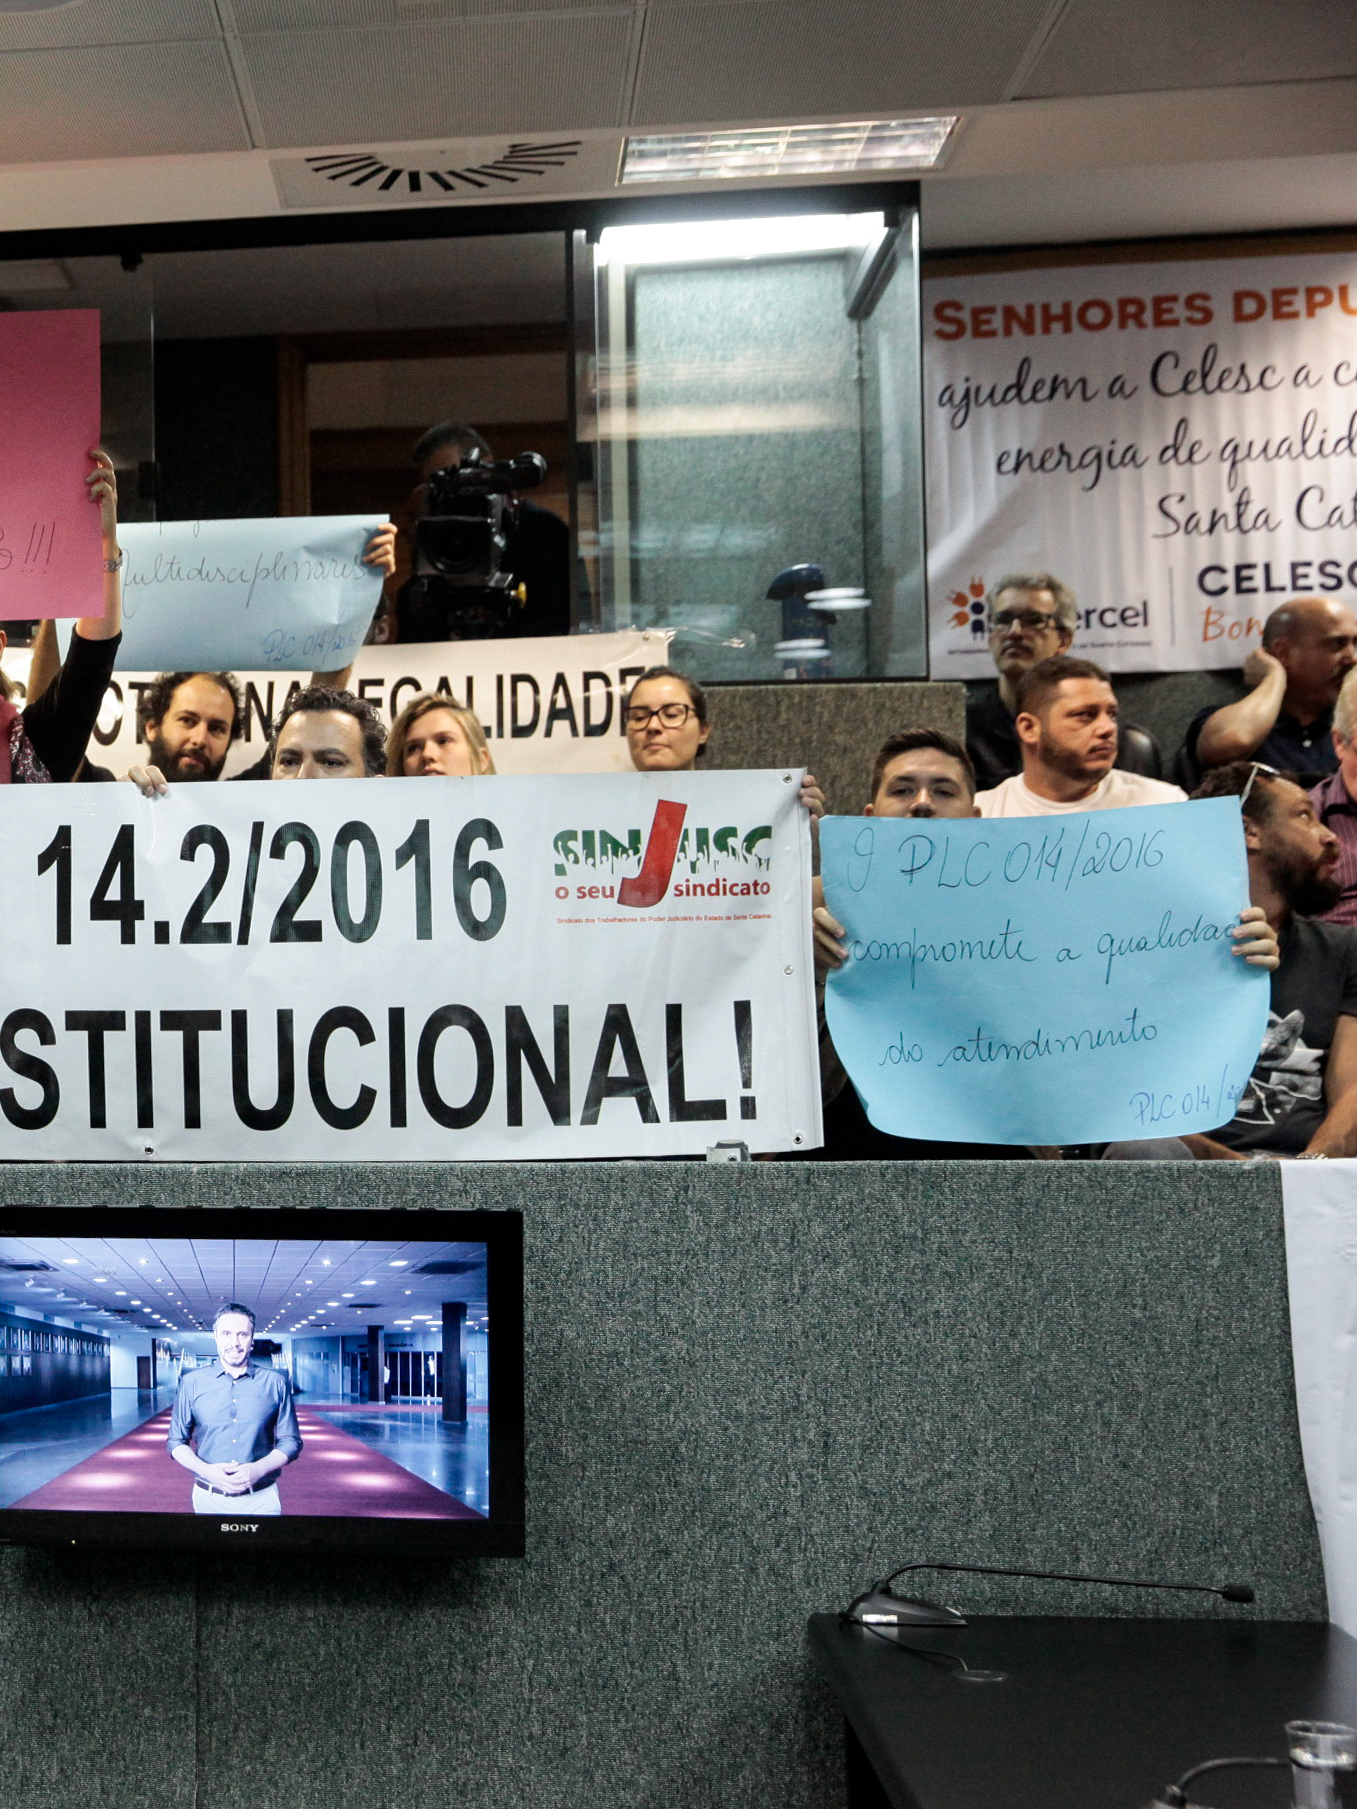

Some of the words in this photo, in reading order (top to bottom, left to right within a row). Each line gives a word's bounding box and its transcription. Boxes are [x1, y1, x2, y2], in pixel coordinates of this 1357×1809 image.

[932, 291, 1215, 341] SENHORES
[938, 357, 1101, 430] ajudem
[1108, 379, 1137, 399] a
[1149, 342, 1285, 398] Celesc
[1293, 365, 1324, 390] a
[996, 440, 1150, 492] energia
[1158, 417, 1214, 467] de
[1152, 486, 1283, 539] Santa
[1075, 600, 1149, 631] ercel
[899, 834, 992, 888] PLC
[1004, 818, 1167, 891] 014/2016
[37, 818, 507, 945] 14.2/2016
[555, 886, 569, 899] o
[577, 885, 615, 899] seu
[674, 878, 771, 897] sindicato
[1055, 943, 1082, 962] a
[937, 1006, 1158, 1068] atendimento
[1129, 1091, 1176, 1126] PLC
[221, 1523, 259, 1532] SONY
